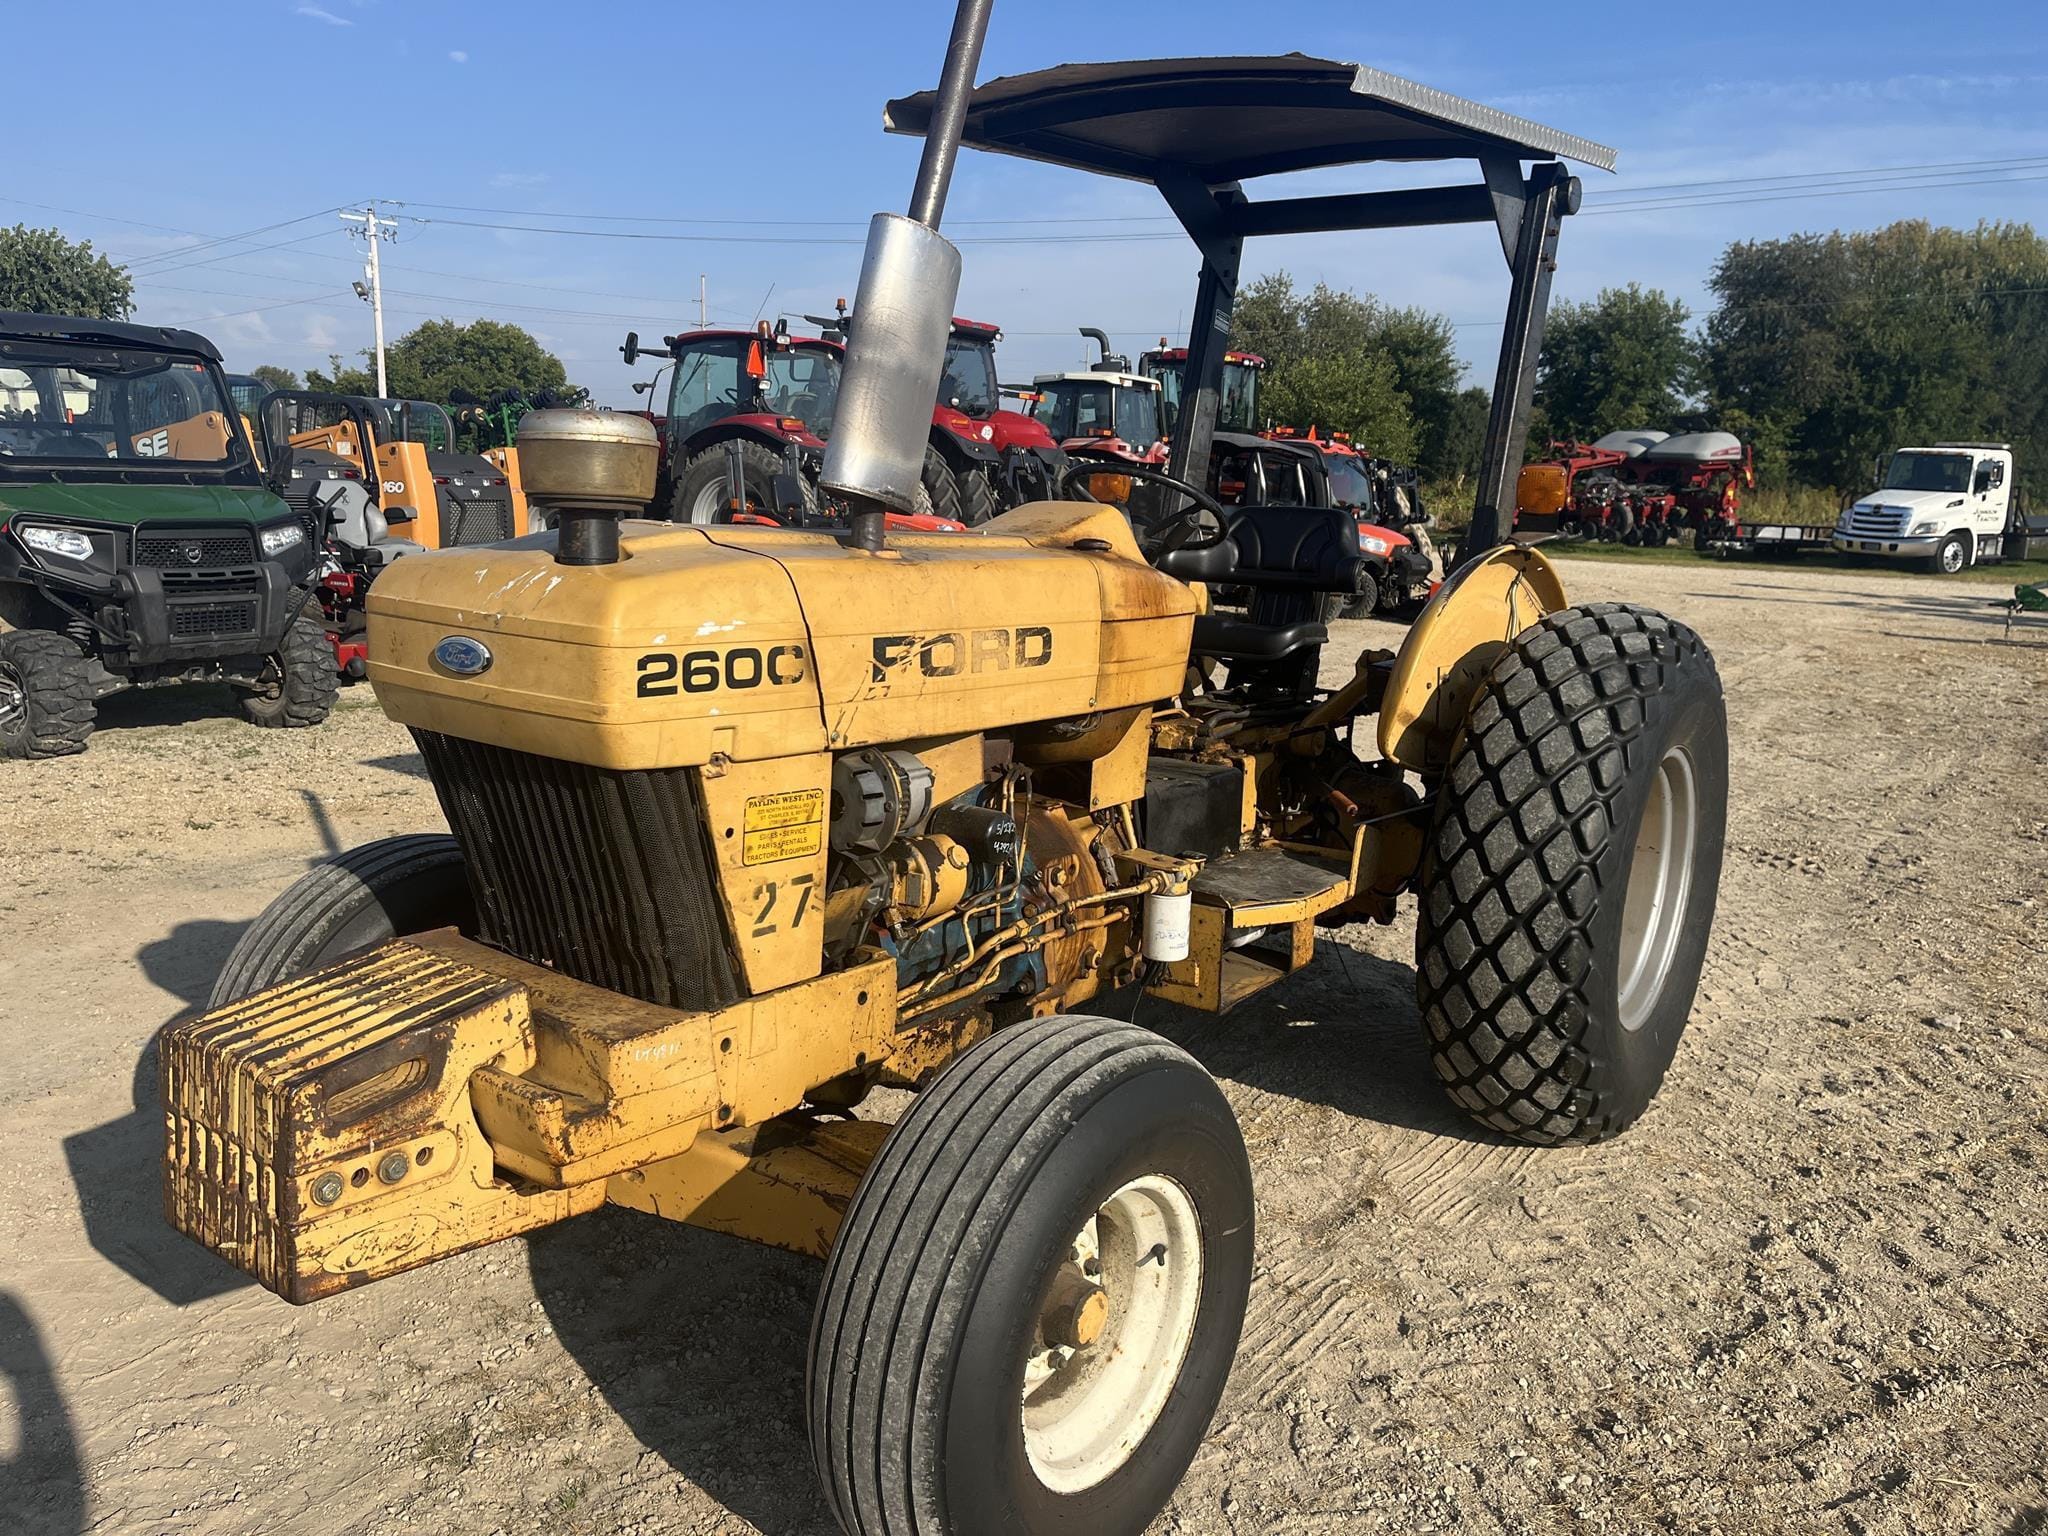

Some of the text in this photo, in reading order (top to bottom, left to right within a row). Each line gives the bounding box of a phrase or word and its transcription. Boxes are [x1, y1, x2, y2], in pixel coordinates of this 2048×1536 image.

[445, 643, 477, 665] Ford
[871, 626, 1053, 684] FORD
[748, 799, 780, 808] PAYLINE
[747, 851, 778, 862] TRACTORS
[751, 873, 814, 938] 27
